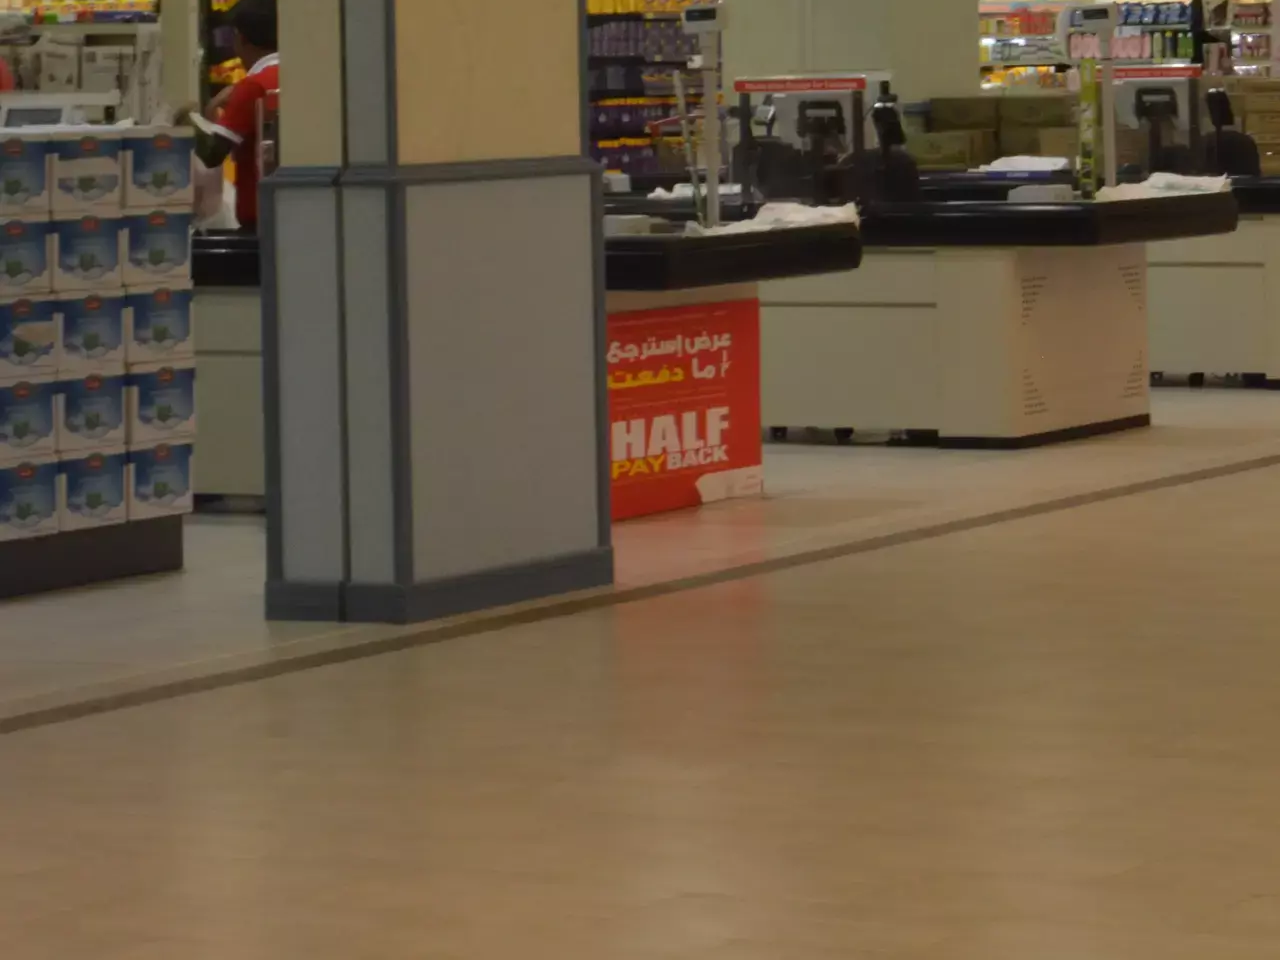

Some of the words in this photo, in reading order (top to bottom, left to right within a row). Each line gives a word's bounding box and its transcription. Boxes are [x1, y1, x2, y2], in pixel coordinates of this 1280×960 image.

[685, 331, 732, 354] عرض
[691, 357, 716, 380] ما
[611, 406, 729, 461] HALF
